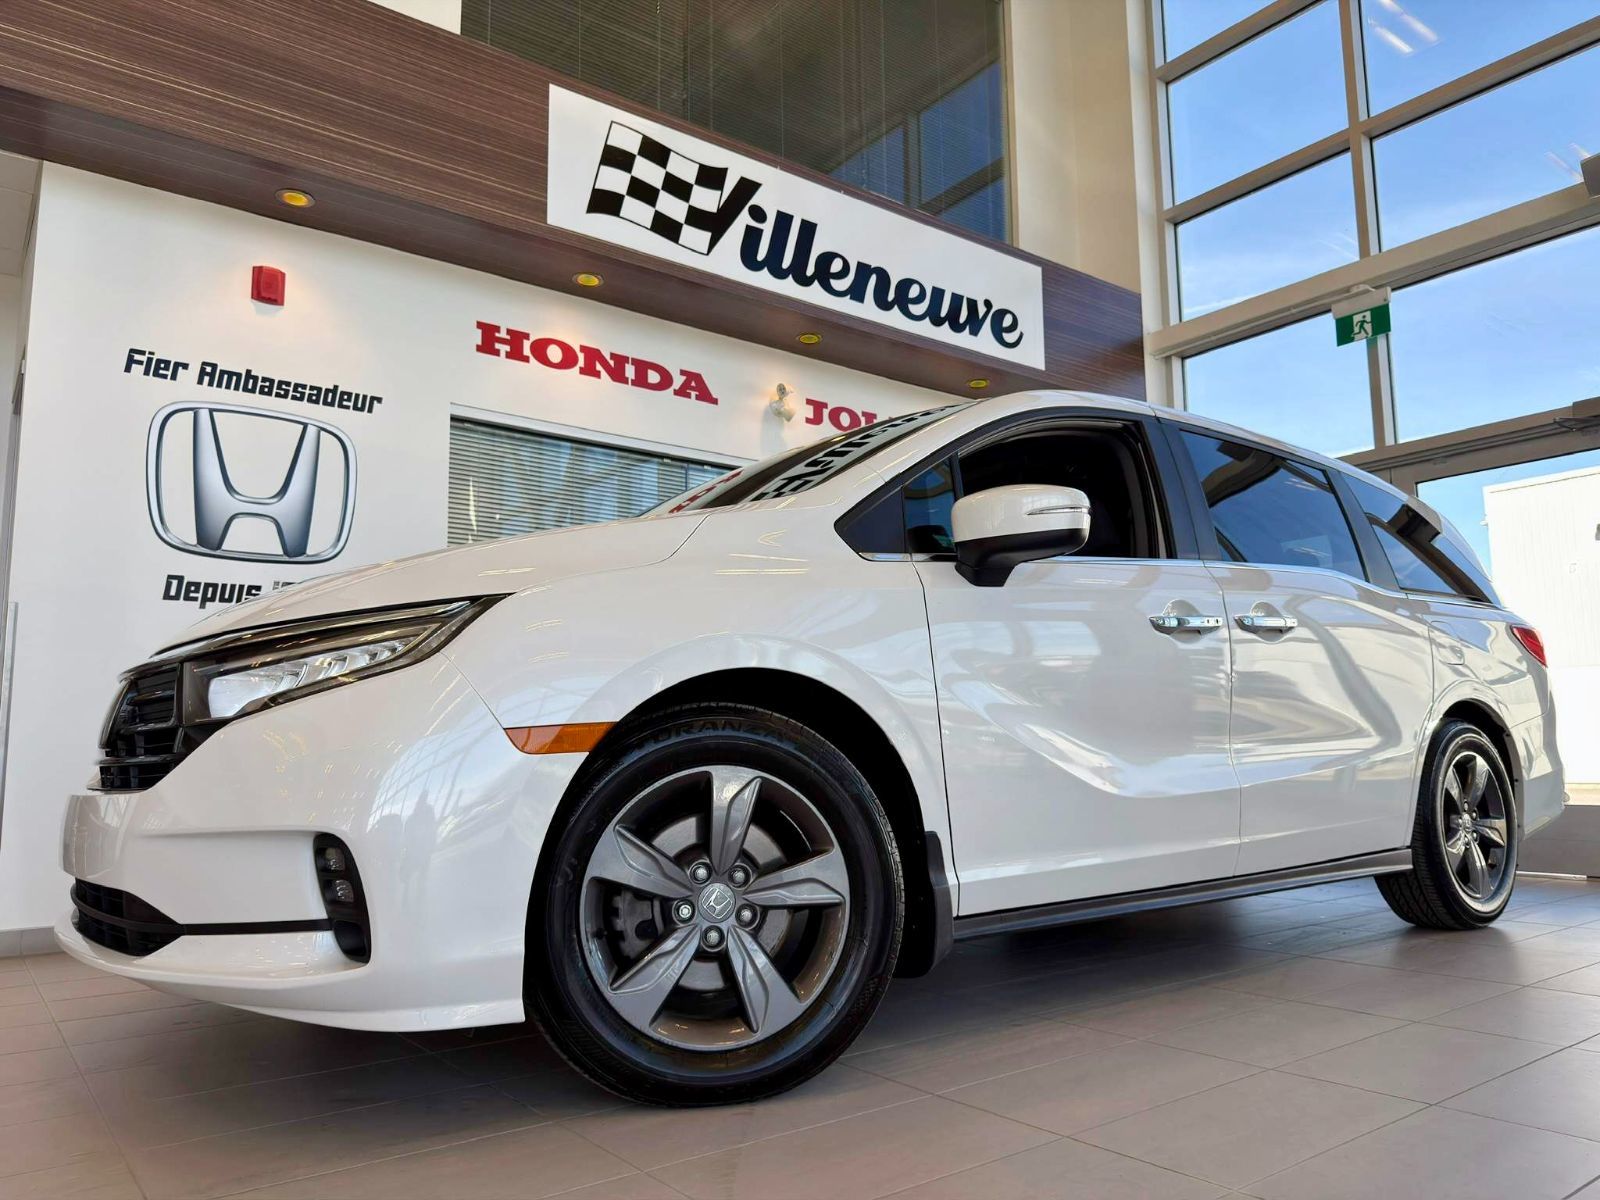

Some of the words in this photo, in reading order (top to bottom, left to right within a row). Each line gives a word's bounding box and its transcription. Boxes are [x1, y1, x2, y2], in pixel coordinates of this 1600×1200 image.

[684, 175, 1024, 349] Villeneuve
[124, 348, 189, 381] Fier
[197, 360, 384, 414] Ambassadeur
[476, 320, 719, 406] HONDA
[162, 574, 262, 609] Depuis
